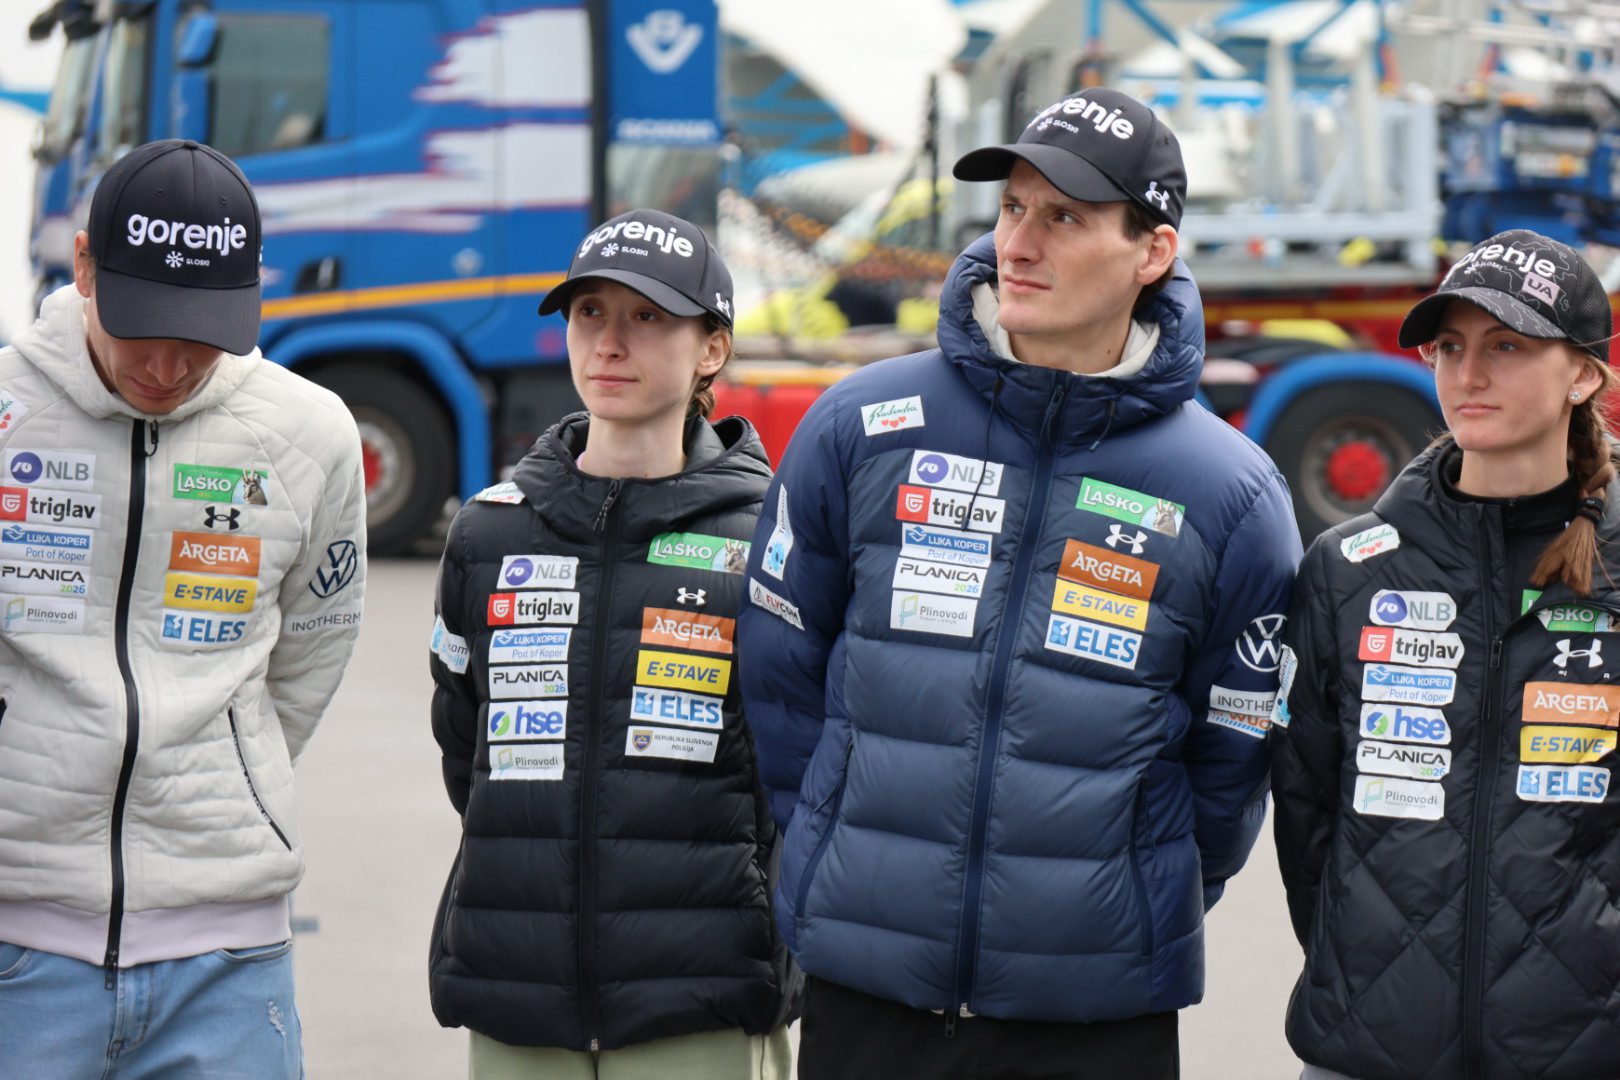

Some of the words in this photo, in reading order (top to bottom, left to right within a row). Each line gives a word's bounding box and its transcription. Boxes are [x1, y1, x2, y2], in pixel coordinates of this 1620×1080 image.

[127, 213, 247, 257] gorenje
[578, 221, 694, 259] gorenje
[1527, 277, 1553, 300] UA
[46, 460, 89, 481] NLB
[951, 464, 996, 486] NLB
[30, 496, 96, 522] triglav
[26, 533, 51, 544] LUKA
[53, 535, 87, 546] KOPER
[928, 536, 952, 547] LUKA
[954, 539, 986, 551] KOPER
[26, 547, 45, 559] Port
[46, 549, 56, 559] of
[58, 551, 86, 562] Koper
[178, 540, 250, 565] ARGETA
[927, 549, 946, 559] Port
[948, 552, 957, 561] of
[959, 554, 985, 565] Koper
[1, 566, 85, 583] PLANICA
[535, 564, 571, 580] NLB
[900, 563, 980, 583] PLANICA
[1071, 550, 1143, 587] ARGETA
[60, 584, 86, 594] 2026
[954, 583, 980, 594] 2026
[27, 609, 78, 620] Plinovodi
[517, 598, 573, 621] triglav
[920, 606, 968, 620] Plinovodi
[1409, 601, 1451, 621] NLB
[188, 617, 246, 643] ELES
[291, 610, 362, 632] INOTHERM
[651, 616, 721, 641] ARGETA
[514, 636, 535, 645] LUKA
[536, 635, 565, 644] KOPER
[1074, 625, 1137, 663] ELES
[1396, 637, 1459, 663] triglav
[512, 649, 528, 659] Port
[530, 649, 538, 657] of
[540, 649, 563, 659] Koper
[493, 670, 564, 684] PLANICA
[1391, 675, 1415, 685] LUKA
[1417, 677, 1450, 687] KOPER
[544, 683, 566, 693] 2026
[1389, 688, 1408, 698] Port
[1410, 691, 1419, 700] of
[1421, 692, 1448, 703] Koper
[660, 694, 720, 724] ELES
[1533, 690, 1610, 715] ARGETA
[515, 705, 563, 735] hse
[1393, 708, 1446, 740] hse
[655, 734, 685, 743] REPUBLIKA
[686, 737, 713, 747] SLOVENIJA
[671, 744, 694, 752] POLICIJA
[1362, 746, 1446, 766] PLANICA
[1420, 766, 1446, 777] 2026
[1546, 771, 1607, 798] ELES
[1385, 790, 1438, 805] Plinovodi
